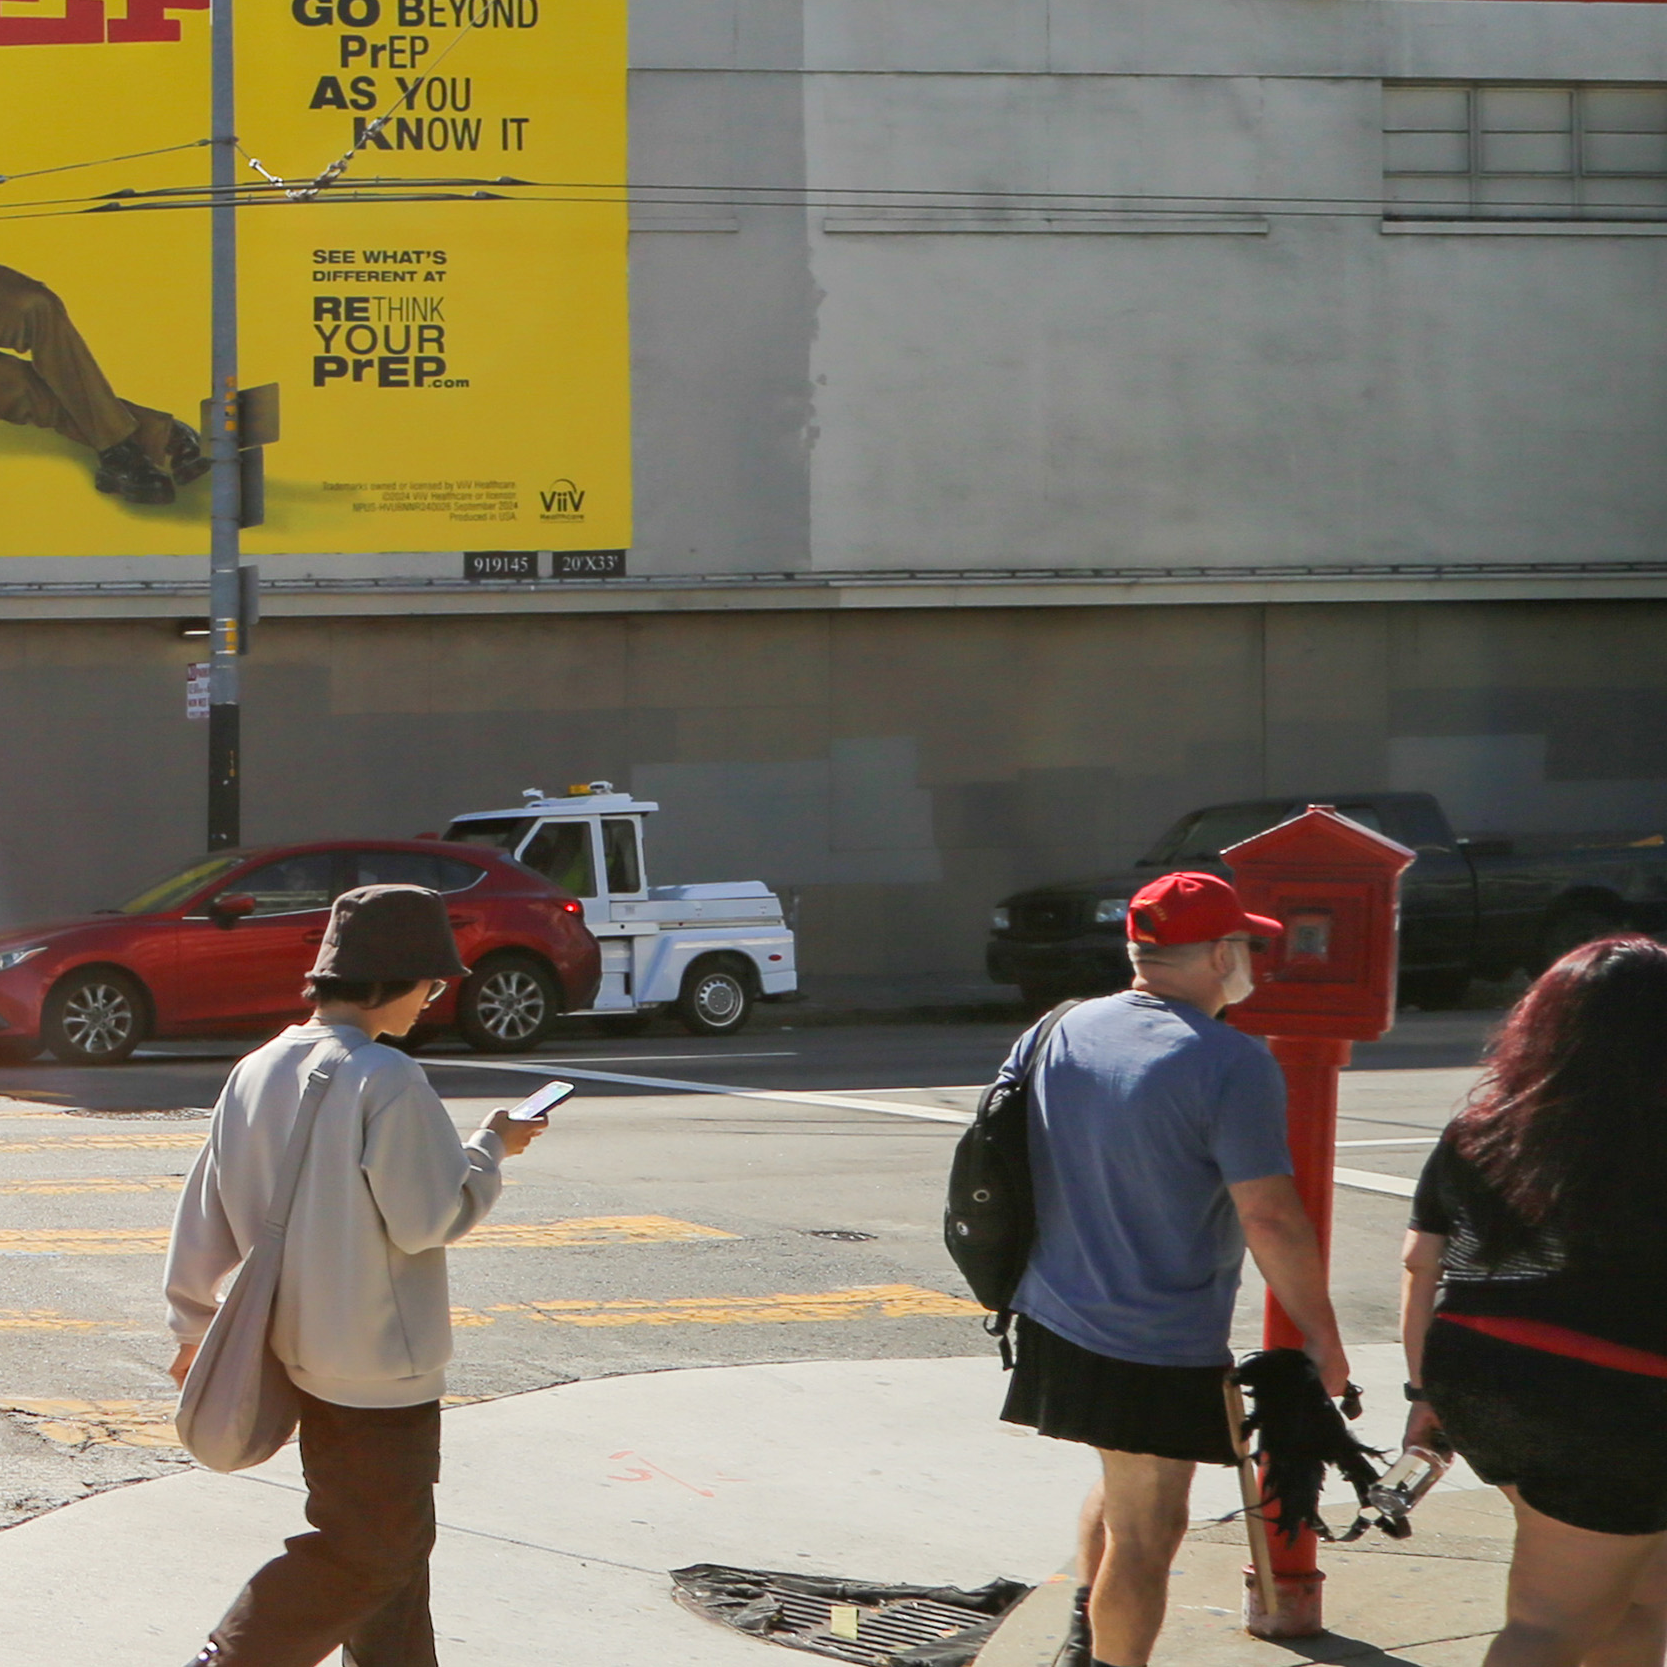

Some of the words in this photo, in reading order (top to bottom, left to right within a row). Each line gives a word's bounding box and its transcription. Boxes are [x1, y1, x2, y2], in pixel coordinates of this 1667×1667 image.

[340, 35, 430, 69] PrEP
[309, 75, 378, 111] AS
[395, 76, 472, 112] YOU
[353, 117, 482, 151] KNOW
[502, 118, 530, 151] IT
[312, 249, 356, 264] SEE
[362, 250, 447, 265] WHAT'S
[312, 270, 418, 282] DIFFERENT
[423, 271, 447, 282] AT
[313, 296, 445, 322] RETHINK
[313, 324, 445, 355] YOUR
[540, 490, 586, 512] ViiV
[474, 557, 528, 573] 919145
